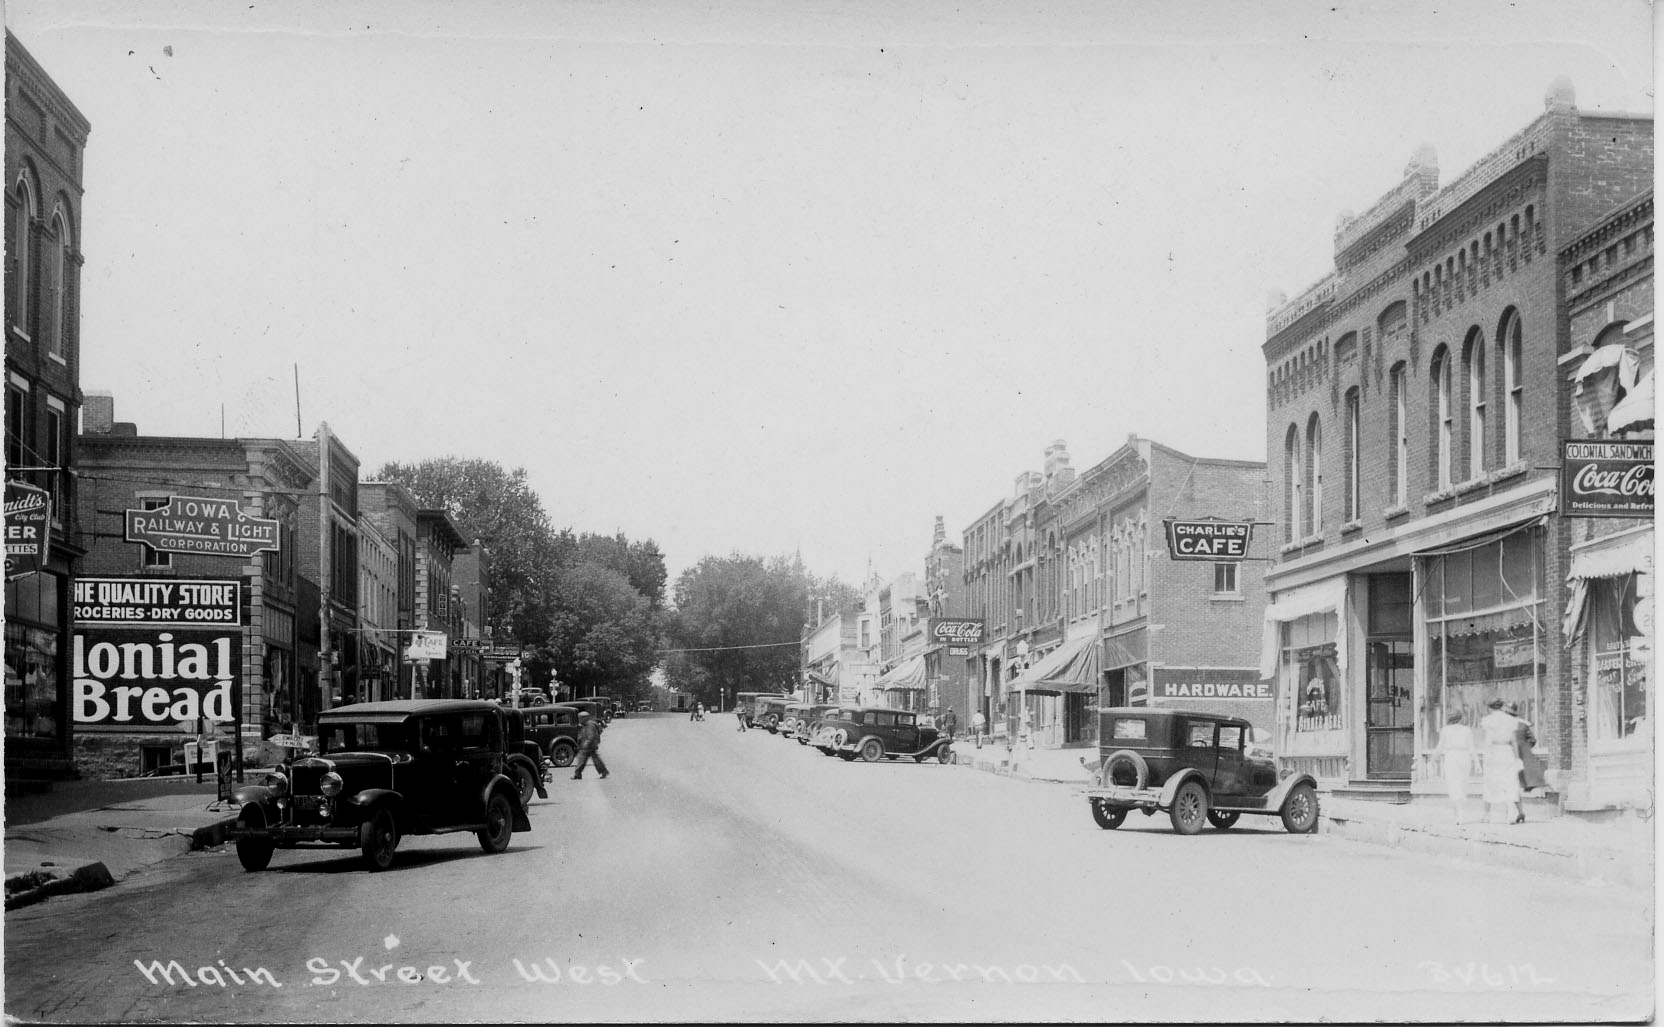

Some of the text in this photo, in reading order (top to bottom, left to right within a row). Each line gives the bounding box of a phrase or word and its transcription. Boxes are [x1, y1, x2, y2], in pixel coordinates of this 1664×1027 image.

[1567, 445, 1652, 460] COLONIAL SANDWICH
[5, 493, 45, 512] midt's
[177, 502, 230, 519] IOWA
[1572, 501, 1654, 510] Delicious and Refre
[5, 526, 37, 539] ER
[134, 517, 272, 541] RAILWAY & LIGHT
[1176, 525, 1246, 537] CHARLIE'S
[160, 538, 248, 553] CORPORATION
[1179, 538, 1242, 554] CAFE
[74, 582, 233, 606] HE QUALITY STORE
[185, 607, 233, 620] GOODS
[934, 621, 984, 638] Coca-Cola
[73, 632, 235, 680] lonial
[73, 679, 235, 722] Bread
